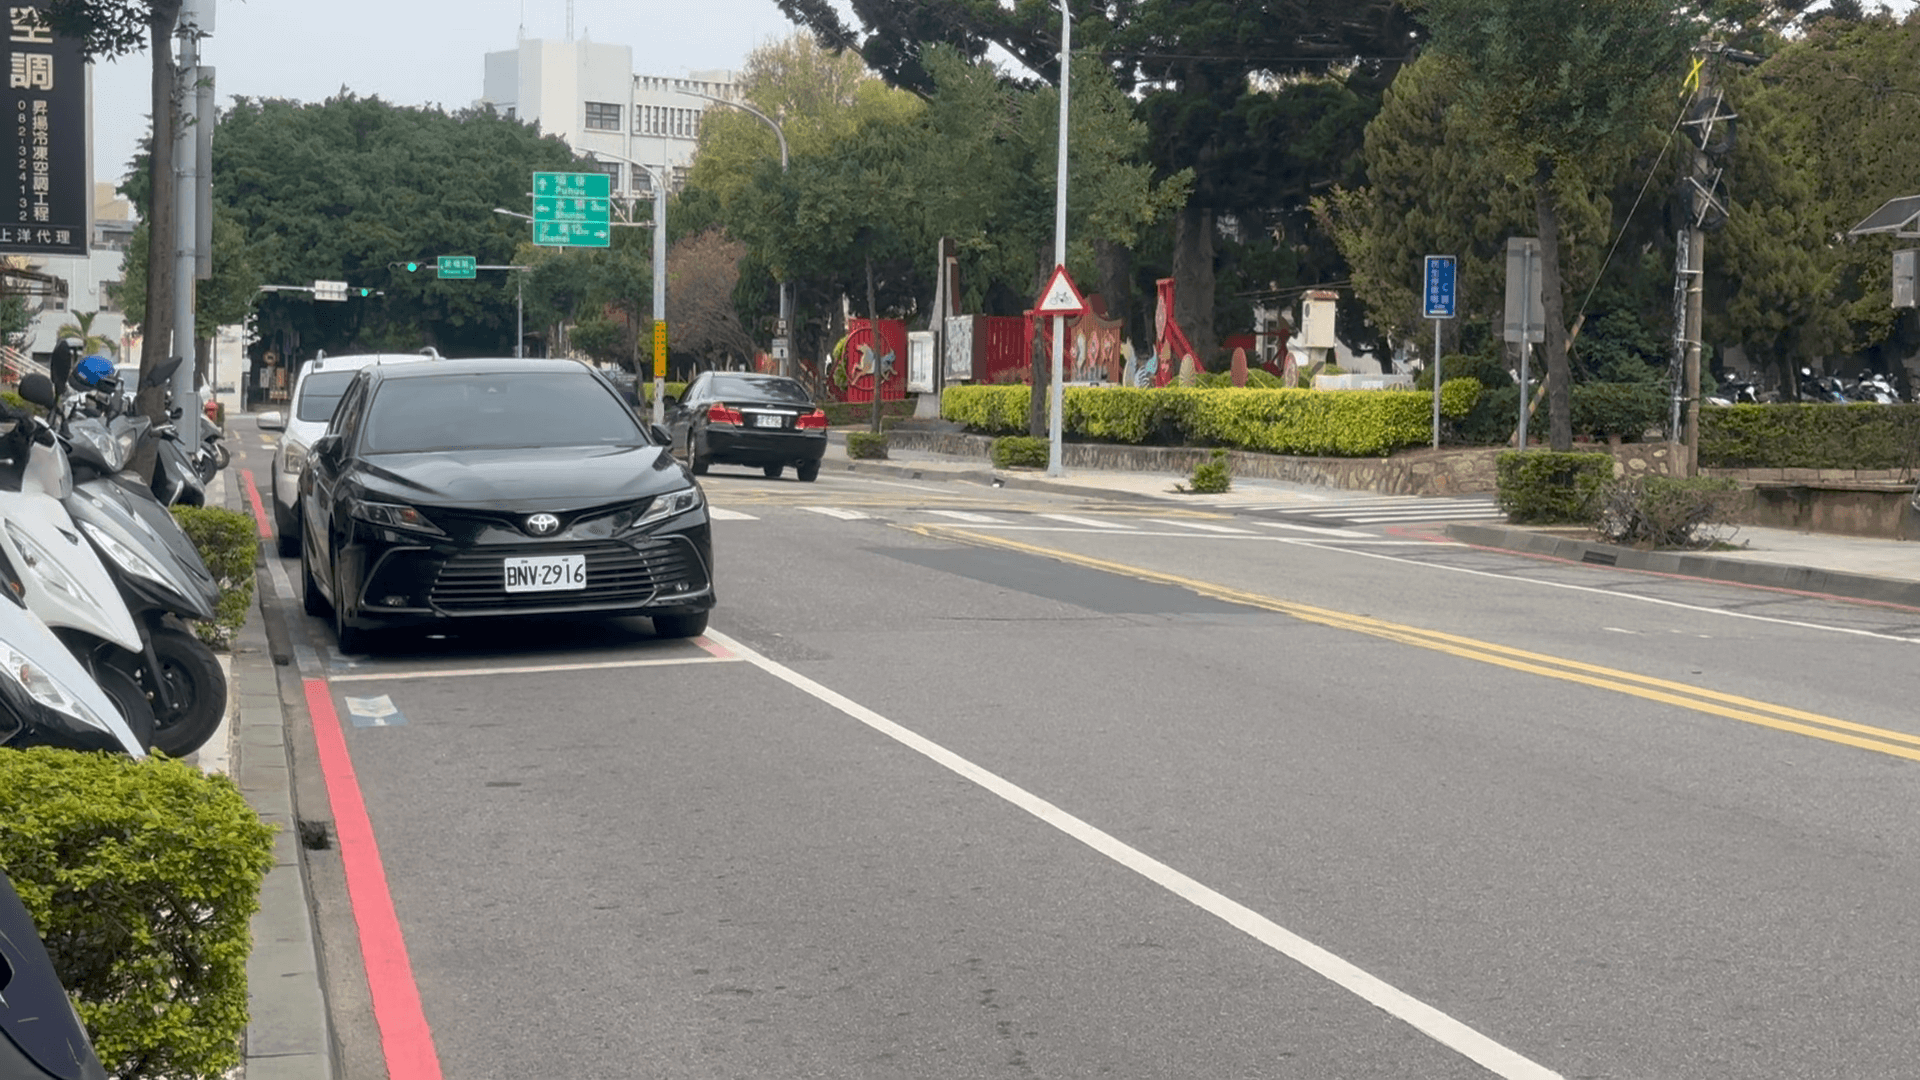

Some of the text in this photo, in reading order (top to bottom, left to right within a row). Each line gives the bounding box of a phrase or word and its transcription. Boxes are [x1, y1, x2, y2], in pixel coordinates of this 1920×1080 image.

[10, 6, 53, 91] 空調
[17, 100, 27, 221] 082-324132
[0, 228, 70, 244] 上洋代理
[507, 563, 584, 587] BNV-2916
